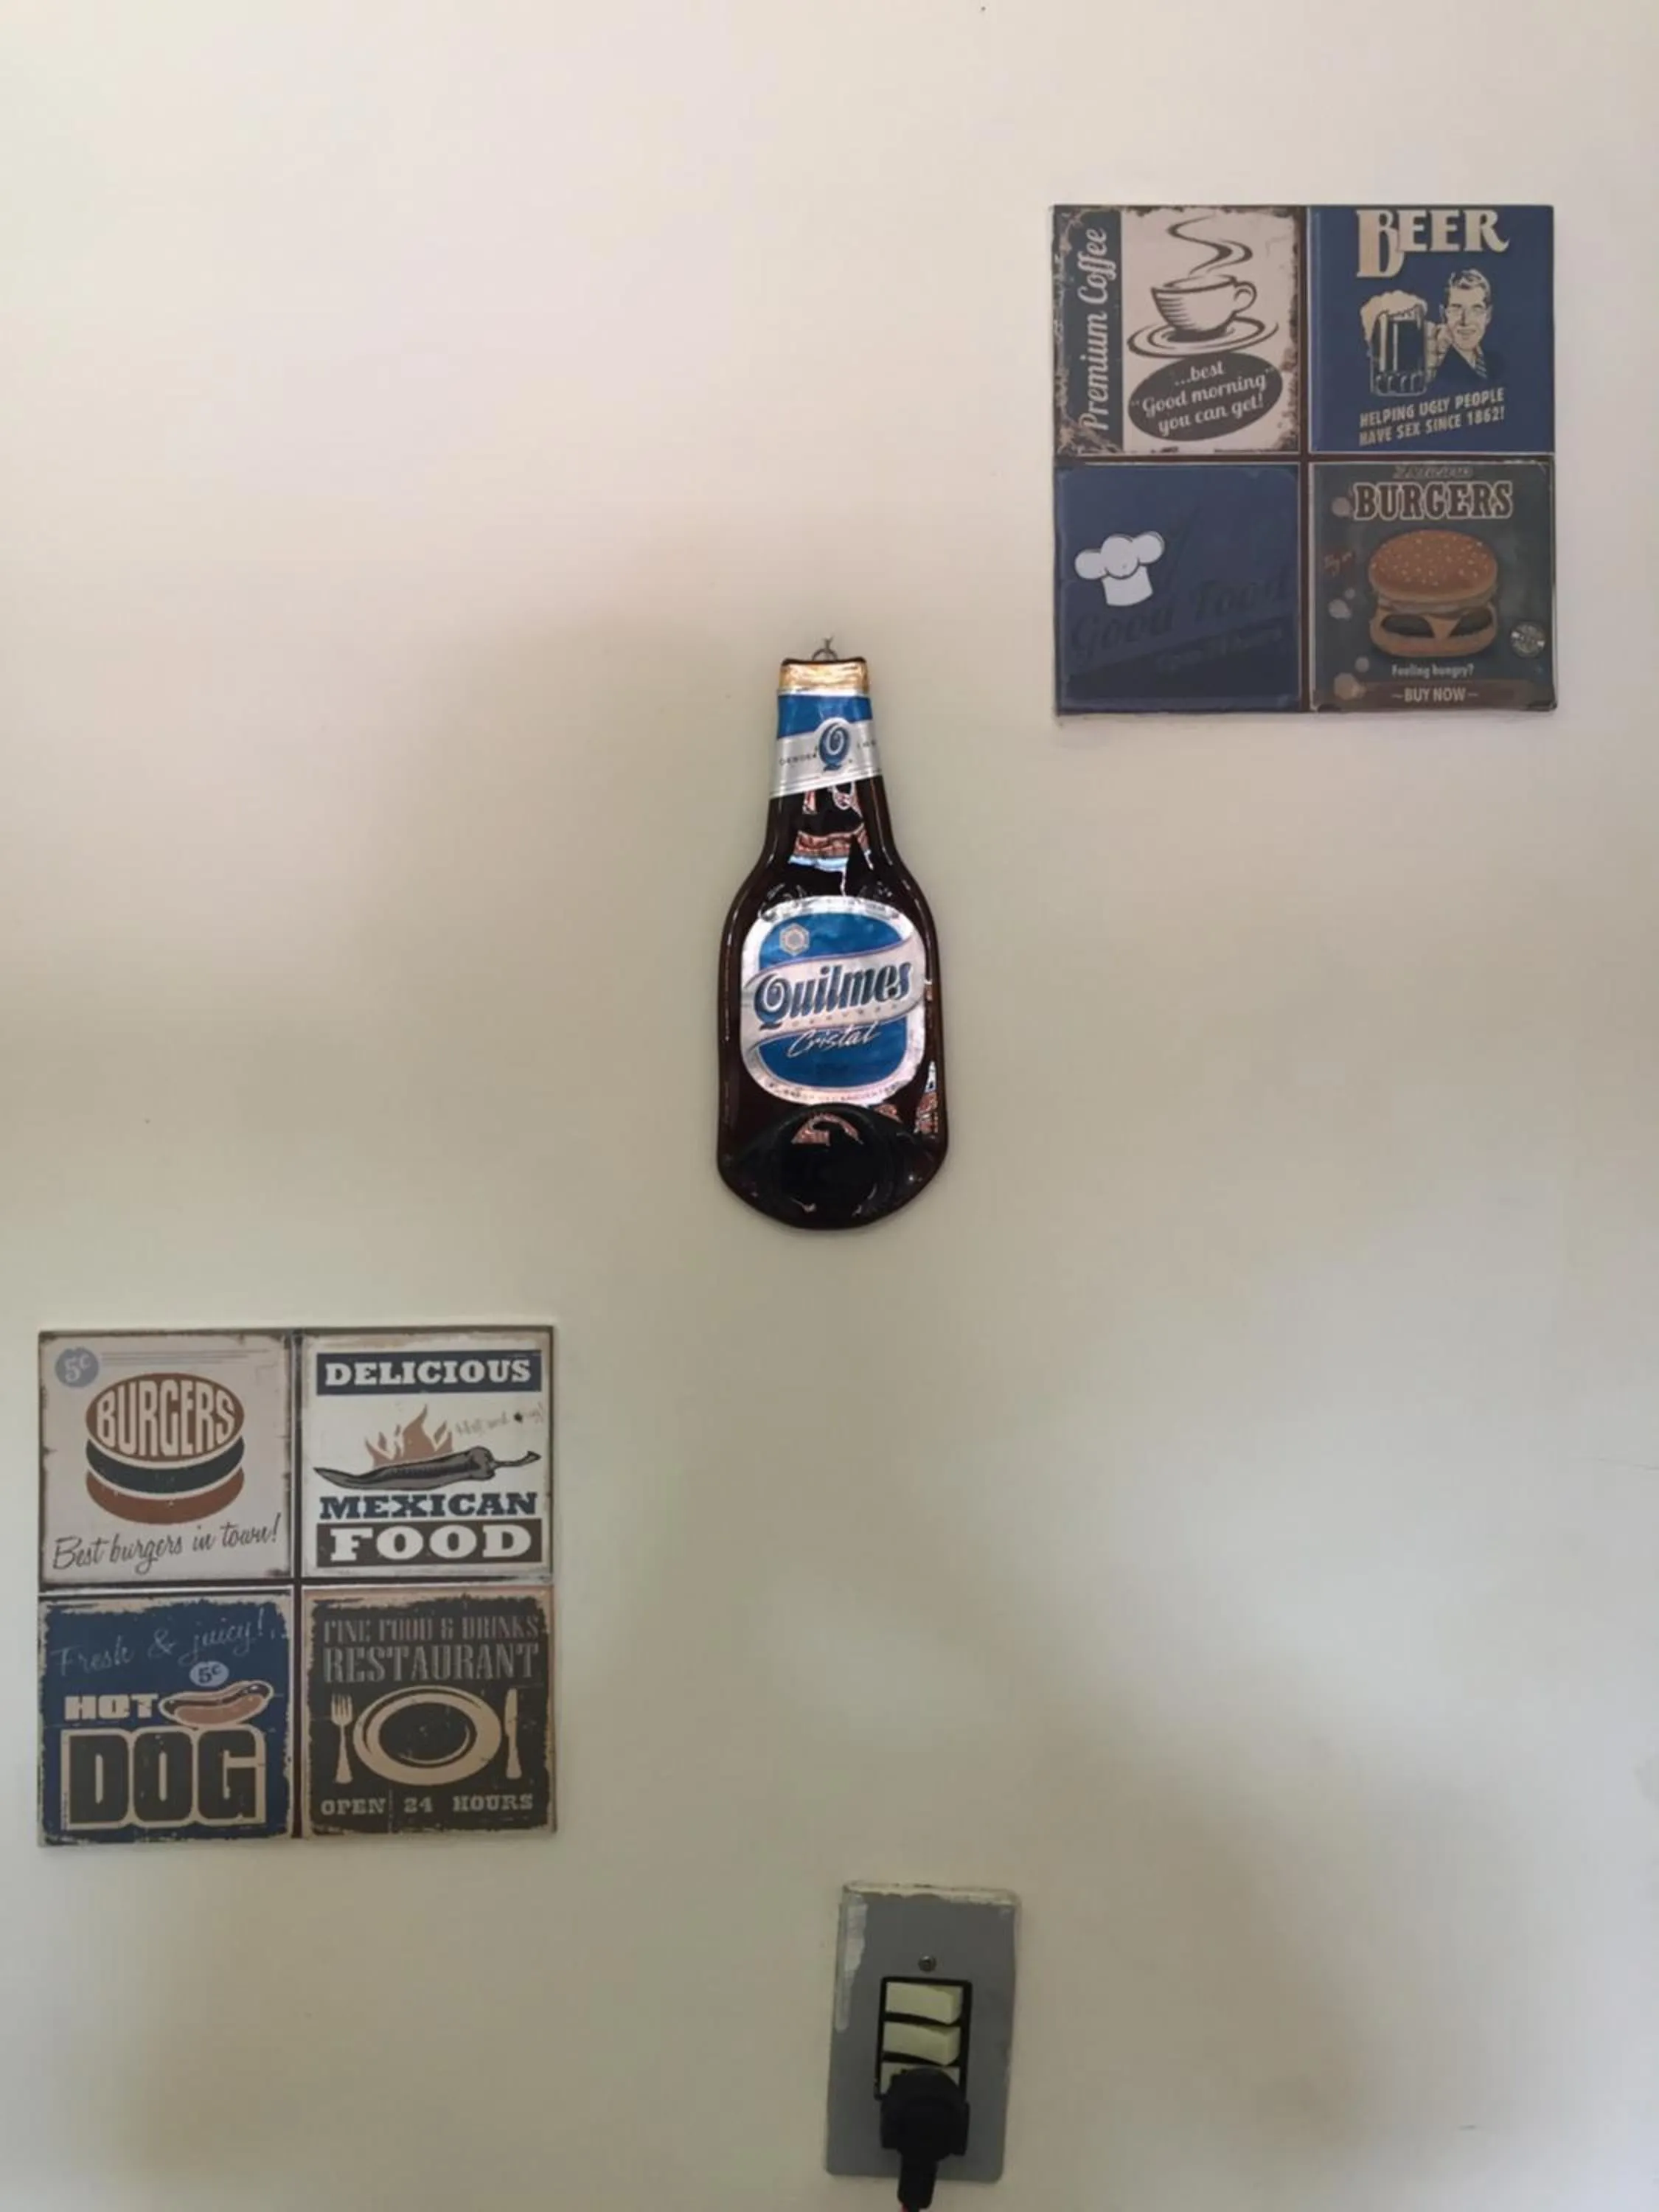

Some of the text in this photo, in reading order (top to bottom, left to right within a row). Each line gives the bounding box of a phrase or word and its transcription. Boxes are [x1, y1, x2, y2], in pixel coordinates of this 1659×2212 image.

[1355, 209, 1510, 279] BEER
[1077, 226, 1116, 431] Premium Coffee
[1158, 392, 1264, 437] you can get!
[1359, 387, 1505, 428] HELPING UGLY PEOPLE
[1359, 406, 1506, 447] HAVE SEX SINCE 1862!
[1353, 481, 1513, 521] BURGERS
[1403, 686, 1467, 703] BUY NOW
[753, 961, 913, 1030] Quilmes
[786, 1021, 882, 1059] Cristal
[324, 1358, 532, 1387] DELICIOUS
[96, 1378, 236, 1458] BURGERS
[319, 1491, 538, 1520] MEXICAN
[52, 1512, 282, 1576] Best burgers in town!
[330, 1523, 532, 1562] FOOD
[50, 1607, 265, 1677] Fresh & juicy!
[323, 1617, 372, 1644] FINE
[378, 1617, 434, 1643] FOOD
[462, 1614, 540, 1639] DRINKS
[322, 1642, 540, 1684] RESTAURANT
[64, 1693, 159, 1721] HOT
[60, 1725, 267, 1832] DOG
[320, 1793, 534, 1816] OPEN 24 HOURS
